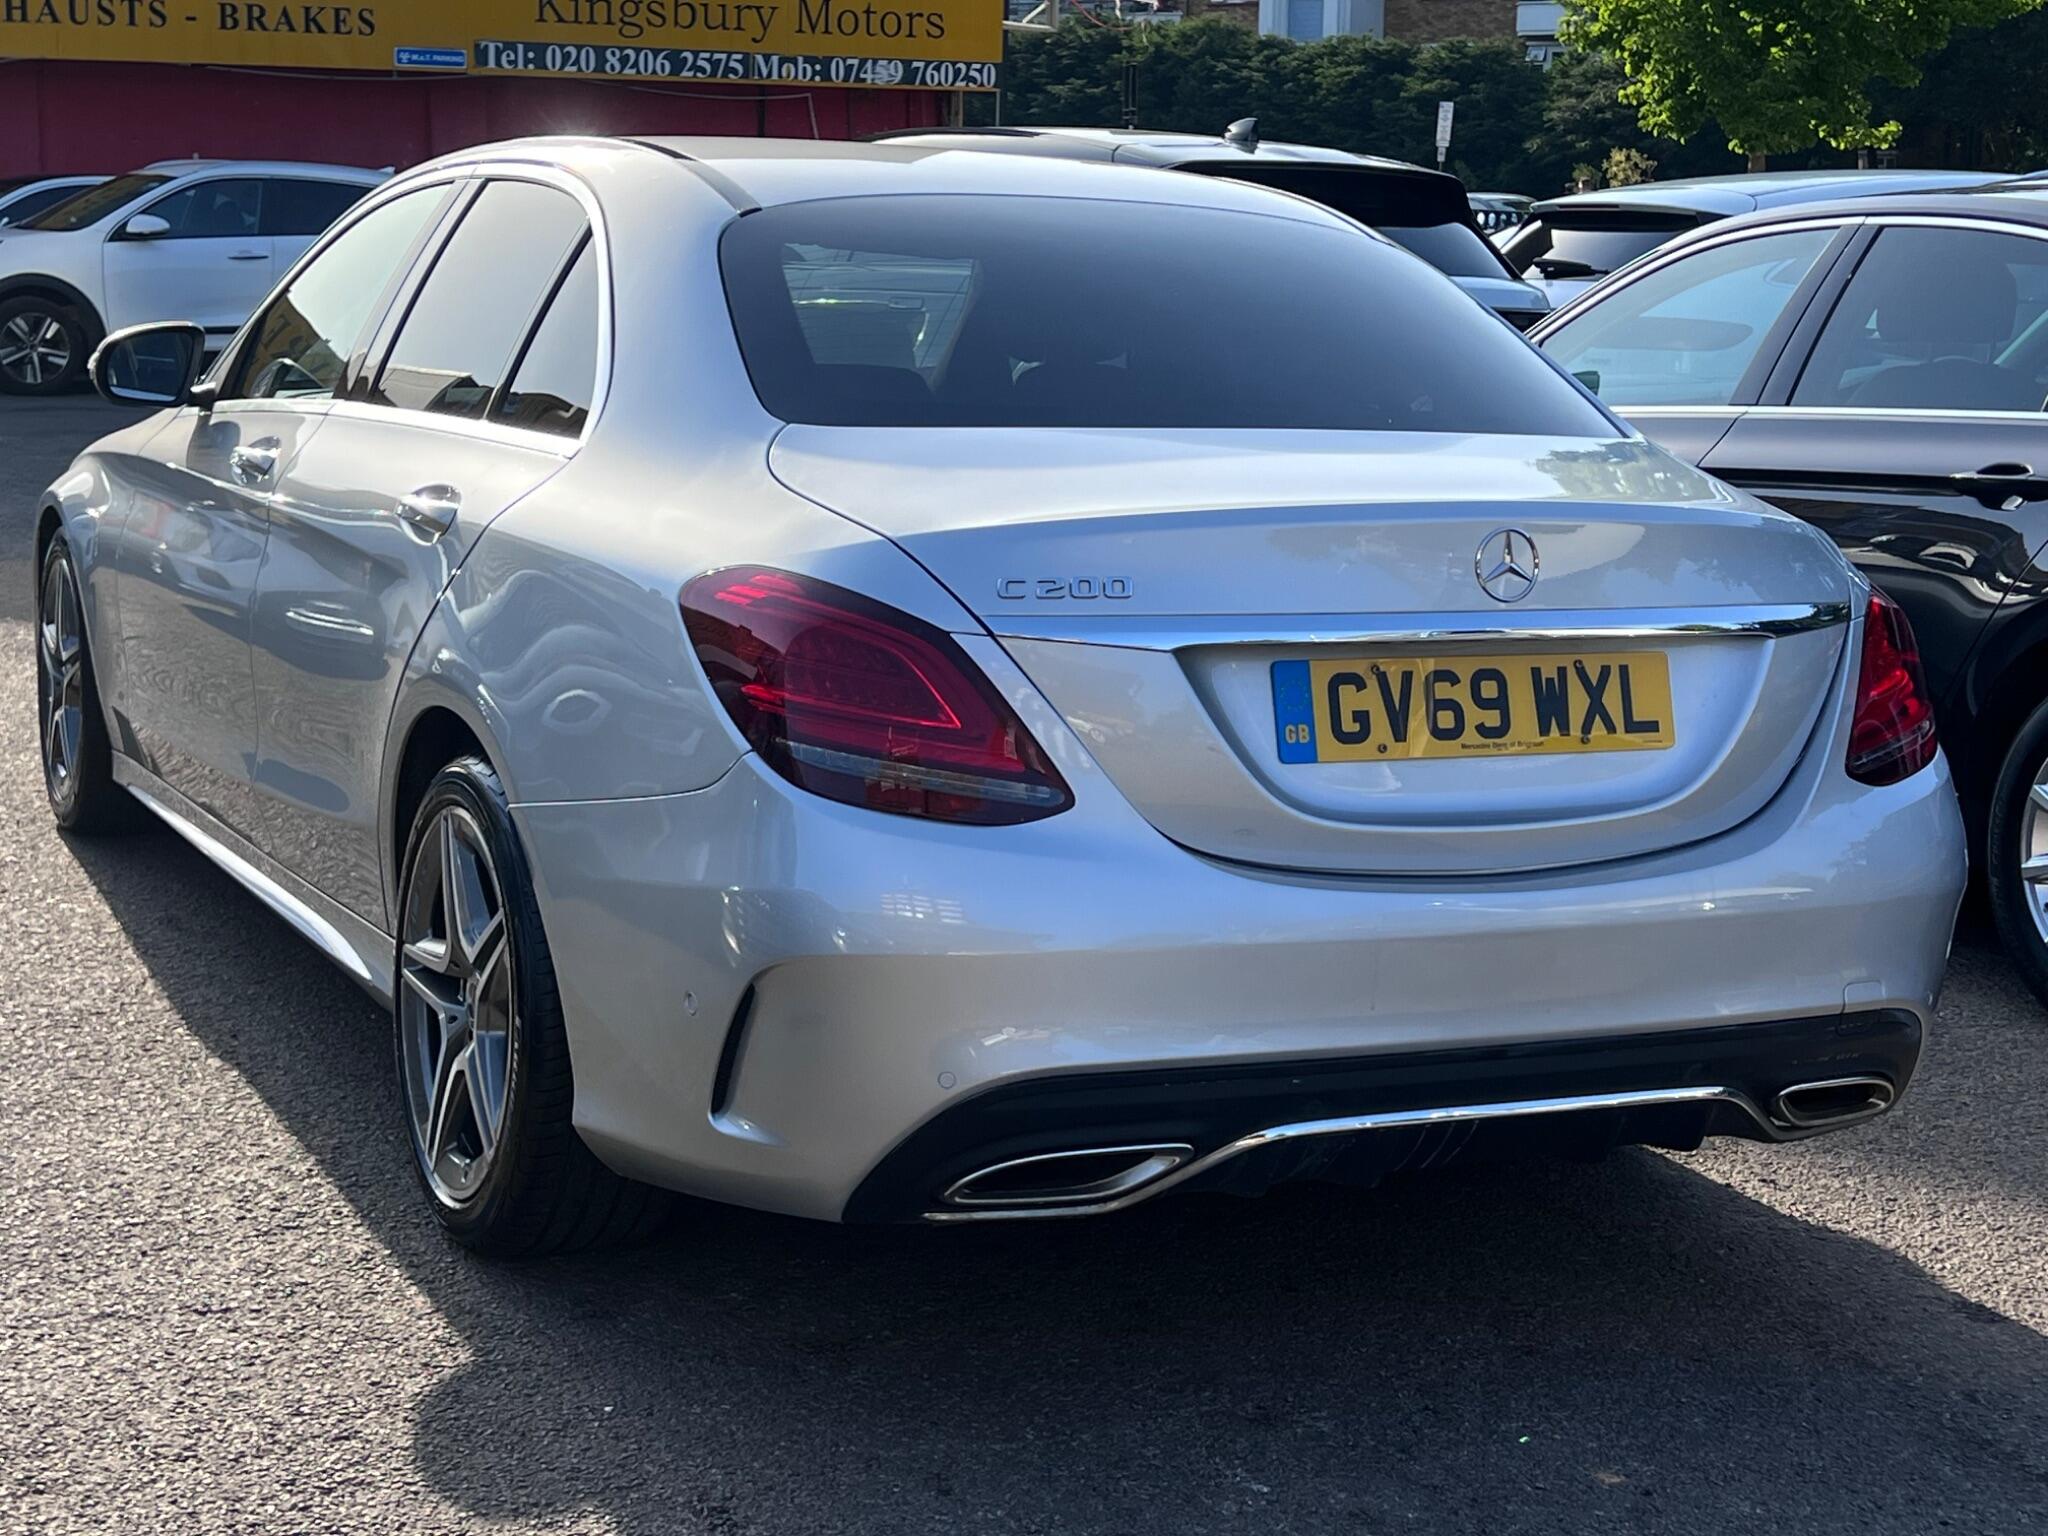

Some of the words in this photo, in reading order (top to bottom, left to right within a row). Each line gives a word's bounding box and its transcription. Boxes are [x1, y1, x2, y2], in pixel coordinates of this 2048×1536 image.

[217, 2, 376, 37] BRAKES
[534, 0, 779, 43] Kingsbury
[795, 0, 946, 39] Motors
[480, 40, 536, 70] Tel:
[545, 44, 597, 73] 020
[604, 47, 671, 77] 8206
[679, 51, 744, 80] 2575
[753, 53, 822, 82] Mob:
[911, 61, 997, 88] 760250
[997, 576, 1027, 600] C
[1036, 576, 1135, 600] 200
[1326, 667, 1513, 746] GV69
[1530, 662, 1661, 738] WXL
[1284, 723, 1310, 744] GB
